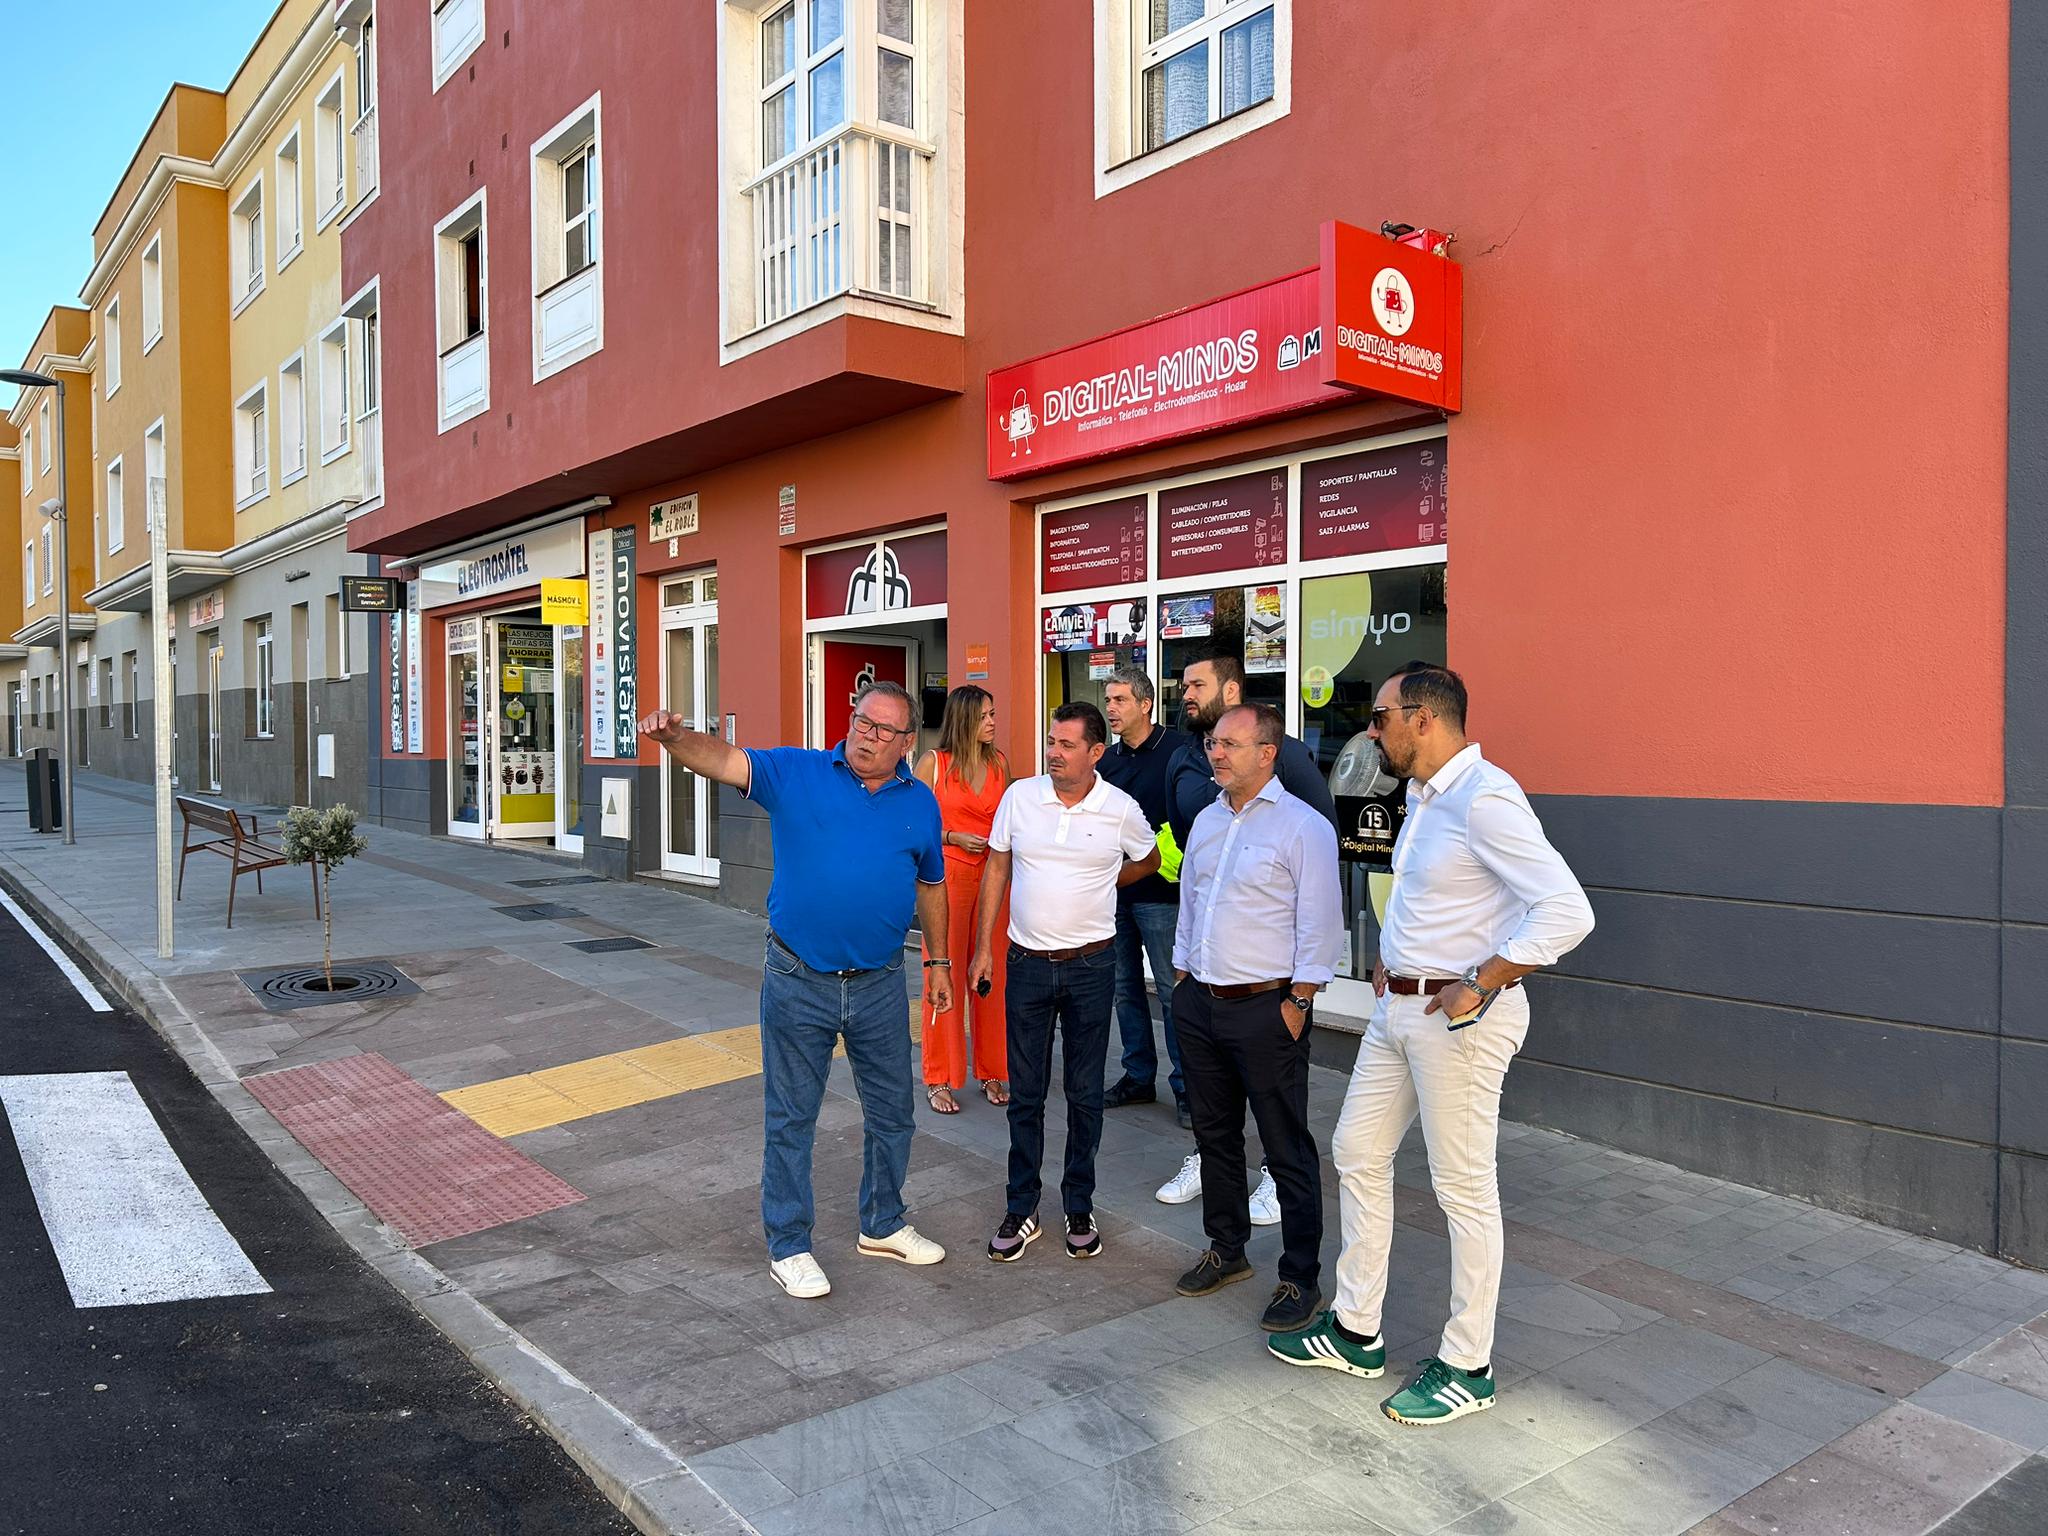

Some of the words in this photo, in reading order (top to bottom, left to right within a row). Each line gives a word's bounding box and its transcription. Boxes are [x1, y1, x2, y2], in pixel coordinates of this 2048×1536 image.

[1337, 325, 1443, 373] DIGITAL-MINDS
[1043, 329, 1259, 426] DIGITAL-MINDS
[1078, 411, 1113, 432] Informática
[1118, 404, 1148, 422] Telefonía
[1154, 388, 1218, 413] Electrodomésticos
[1225, 380, 1248, 394] Hogar
[1319, 475, 1353, 488] SOPORTES
[1358, 467, 1397, 481] PANTALLAS
[1212, 499, 1228, 507] PILAS
[1319, 493, 1340, 503] REDES
[670, 500, 692, 515] EDIFICIO
[1319, 506, 1358, 519] VIGILANCIA
[665, 520, 673, 533] EL
[674, 514, 695, 531] ROBLE
[1171, 518, 1200, 529] CABLEADO
[1203, 509, 1251, 524] CONVERTIDORES
[1050, 526, 1066, 535] IMAGEN
[1071, 523, 1090, 532] SONIDO
[1171, 531, 1205, 543] IMPRESORAS
[1208, 524, 1249, 538] CONSUMIBLES
[1318, 527, 1334, 536] SAIS
[1338, 521, 1370, 533] ALARMAS
[1077, 546, 1110, 557] SMARTWATCH
[1171, 543, 1222, 557] ENTRETENIMIENTO
[458, 542, 528, 594] ELECTROSÁTEL
[1072, 557, 1119, 570] ELECTRODOMÉSTICO
[508, 630, 521, 638] LAS
[1310, 608, 1411, 646] simyo
[508, 640, 537, 648] TARIFAS
[508, 649, 551, 657] AHORRAR
[967, 655, 987, 664] simyo
[1366, 811, 1383, 828] 15
[1349, 842, 1375, 853] Digital
